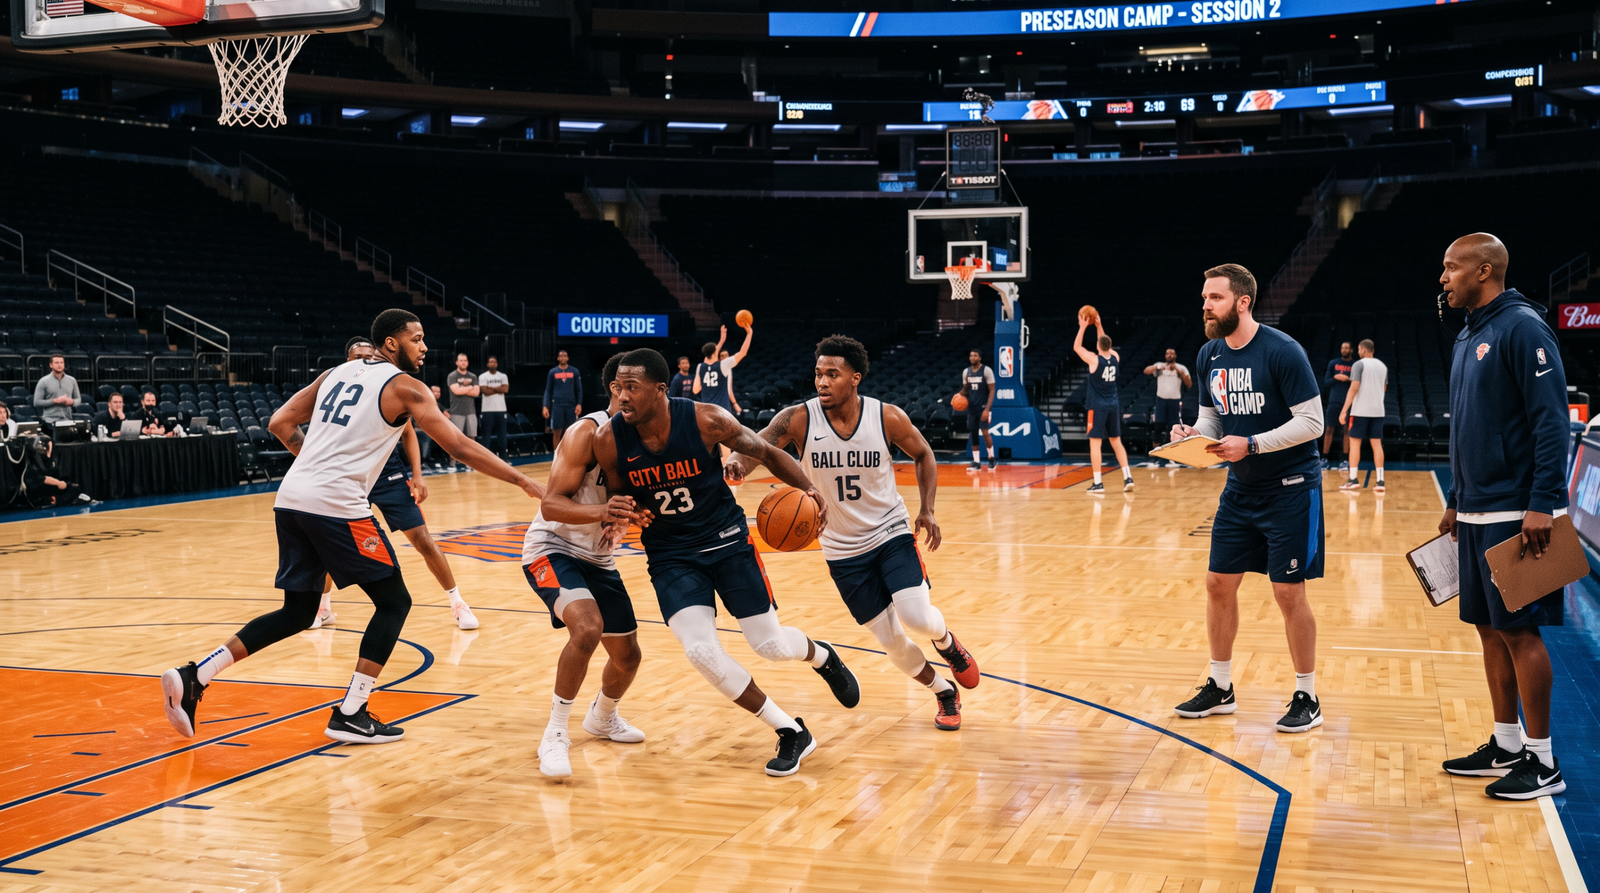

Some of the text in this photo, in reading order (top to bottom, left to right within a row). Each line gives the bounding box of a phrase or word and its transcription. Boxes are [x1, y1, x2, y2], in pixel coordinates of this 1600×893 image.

[1020, 7, 1119, 32] PRESEASON
[1123, 4, 1174, 28] CAMP
[1191, 0, 1265, 24] SESSION
[1269, 0, 1281, 18] 2
[1328, 92, 1336, 104] 0
[1371, 90, 1376, 101] 1
[571, 316, 655, 334] COURTSIDE
[703, 371, 719, 387] 42
[1101, 365, 1117, 382] 42
[1228, 368, 1253, 392] NBA
[319, 380, 364, 427] 42
[1229, 392, 1266, 415] CAMP
[811, 450, 881, 469] BALL CLUB
[628, 465, 661, 487] CITY
[664, 458, 702, 481] BALL
[834, 474, 862, 502] 15
[654, 487, 695, 515] 23
